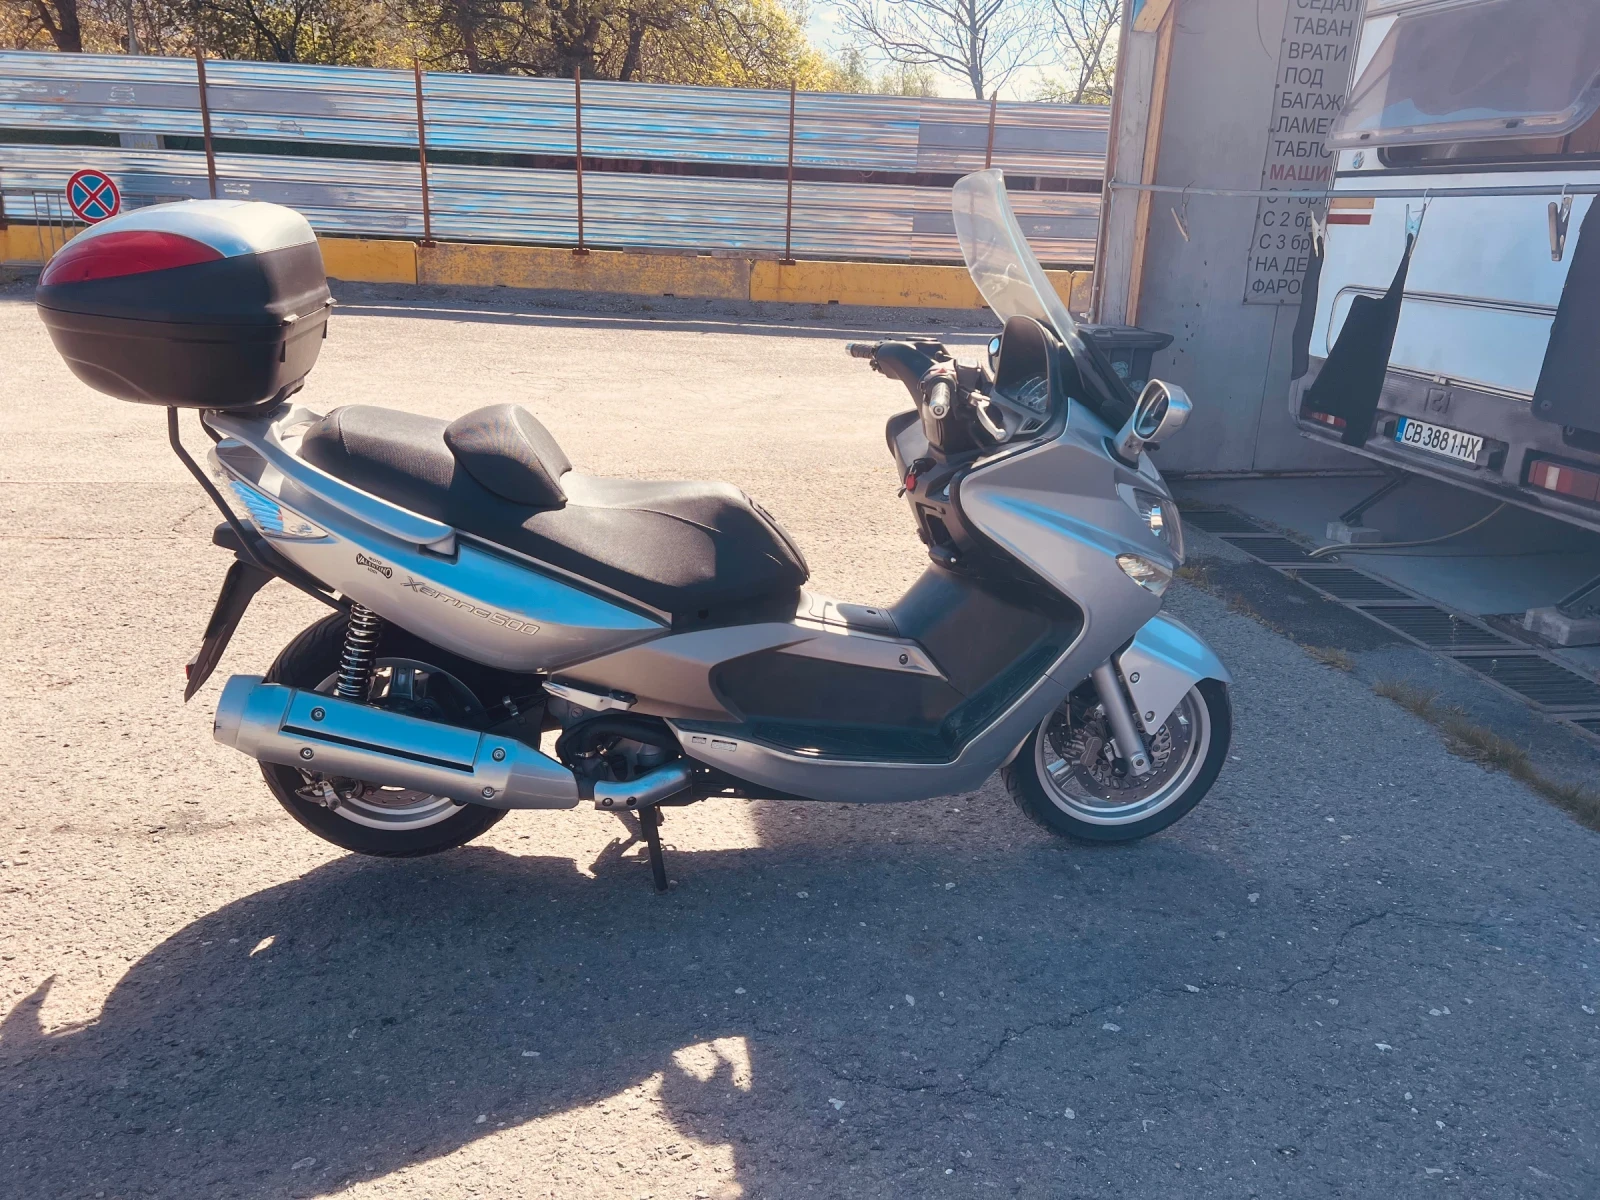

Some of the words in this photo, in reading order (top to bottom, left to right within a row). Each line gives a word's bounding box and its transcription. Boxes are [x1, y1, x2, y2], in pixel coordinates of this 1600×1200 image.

[1293, 16, 1353, 37] ТАВАН
[1288, 42, 1347, 62] ВРАТИ
[1284, 67, 1324, 89] ПОД
[1276, 115, 1335, 134] ЛАМЕ
[1263, 210, 1276, 227] С
[1279, 211, 1290, 227] 2
[1259, 233, 1272, 250] С
[1276, 234, 1286, 250] 3
[1255, 256, 1279, 272] НА
[357, 554, 392, 578] VALENTINO
[489, 612, 541, 636] 500
